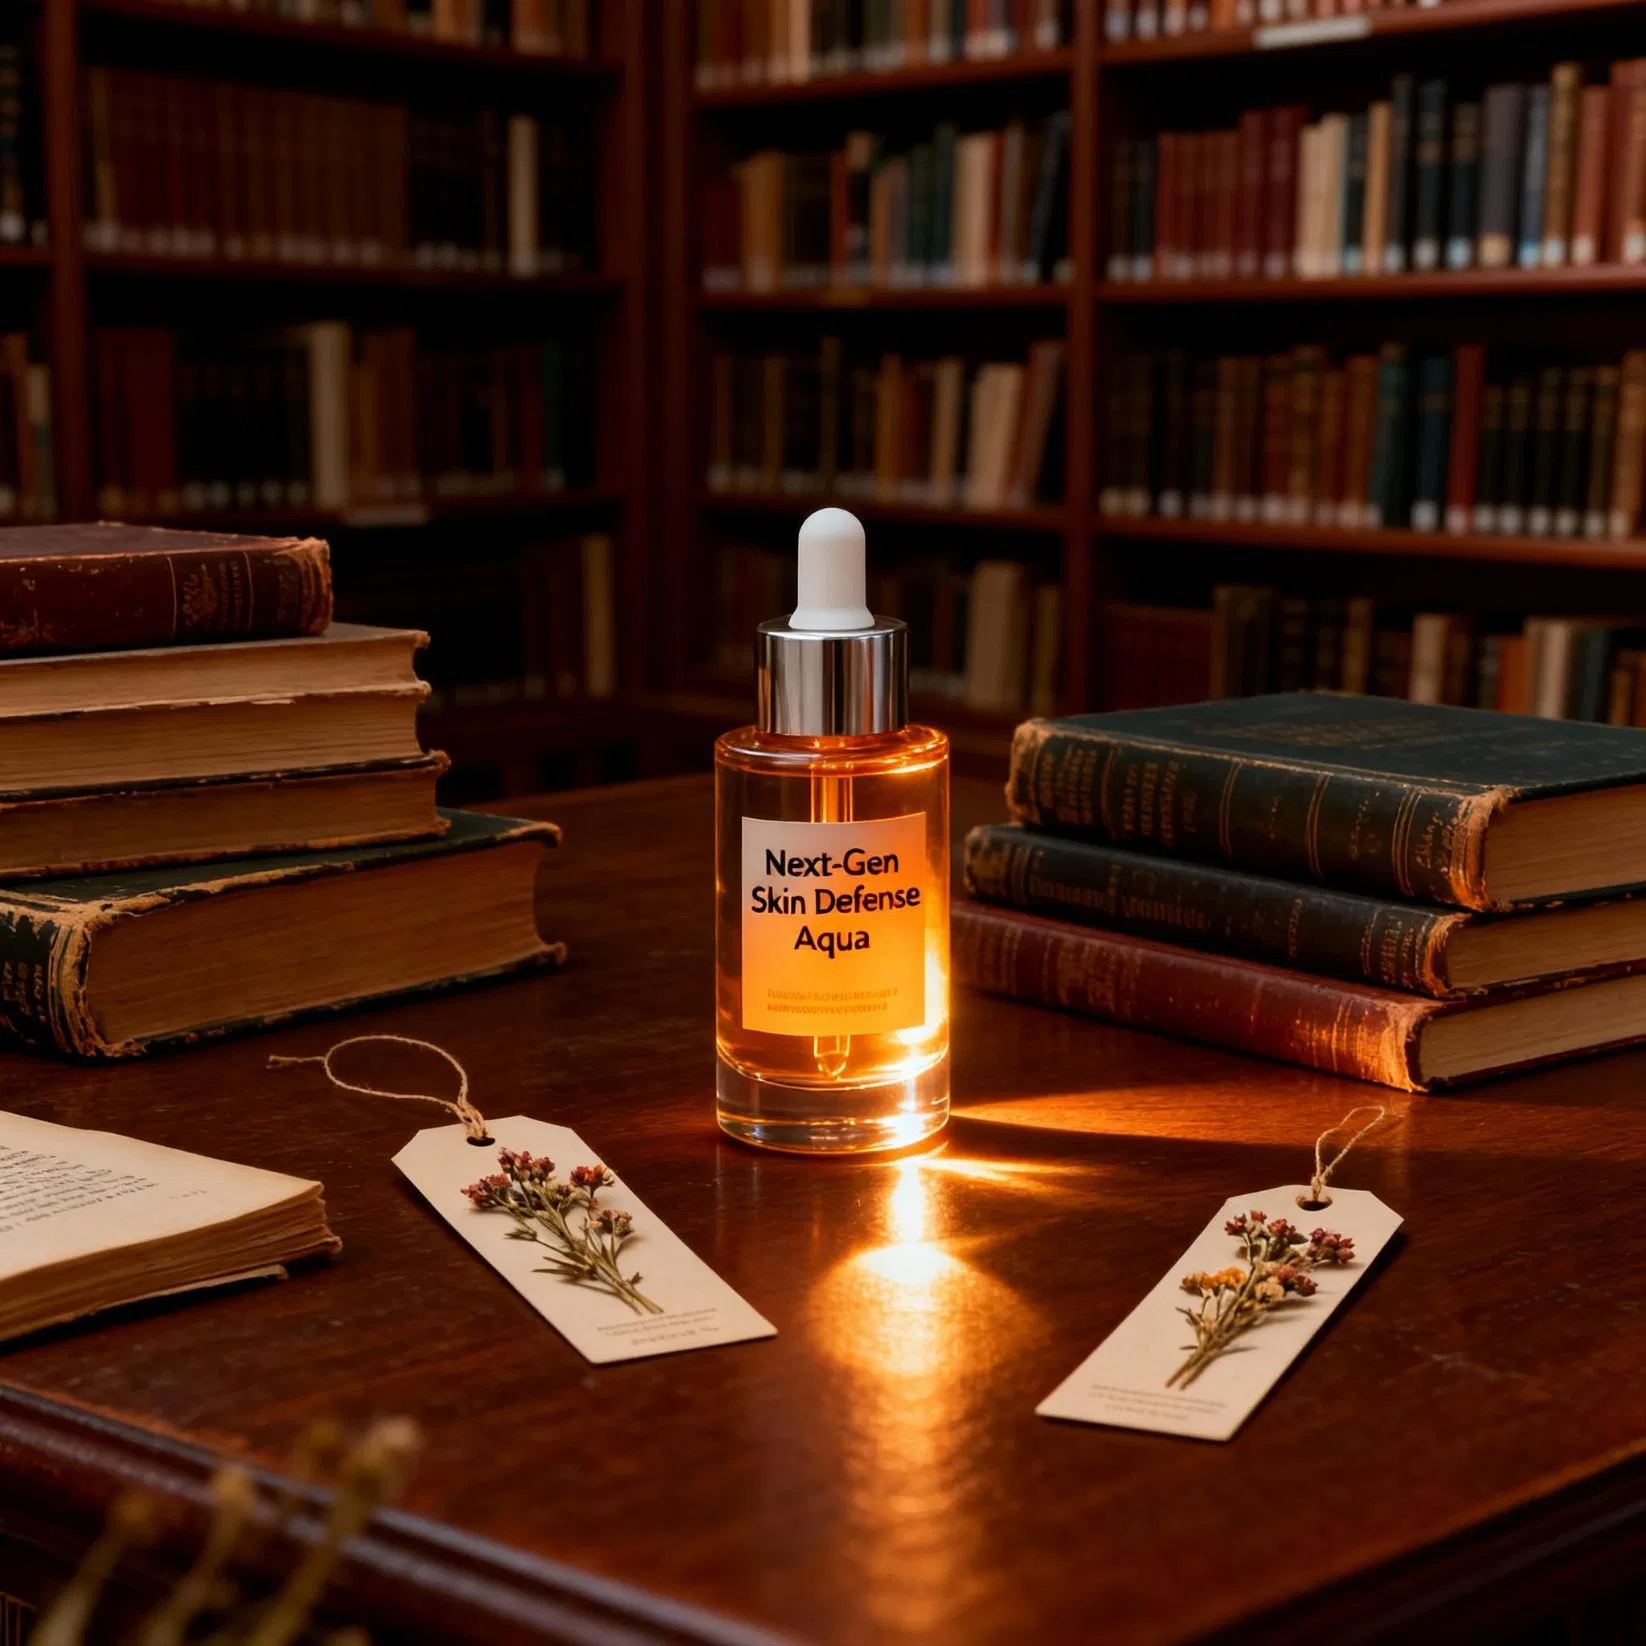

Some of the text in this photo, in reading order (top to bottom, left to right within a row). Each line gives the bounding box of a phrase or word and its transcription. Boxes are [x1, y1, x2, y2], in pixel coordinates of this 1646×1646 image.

[765, 848, 899, 877] Next-Gen
[751, 884, 921, 915] Skin Defense
[794, 925, 870, 960] Aqua
